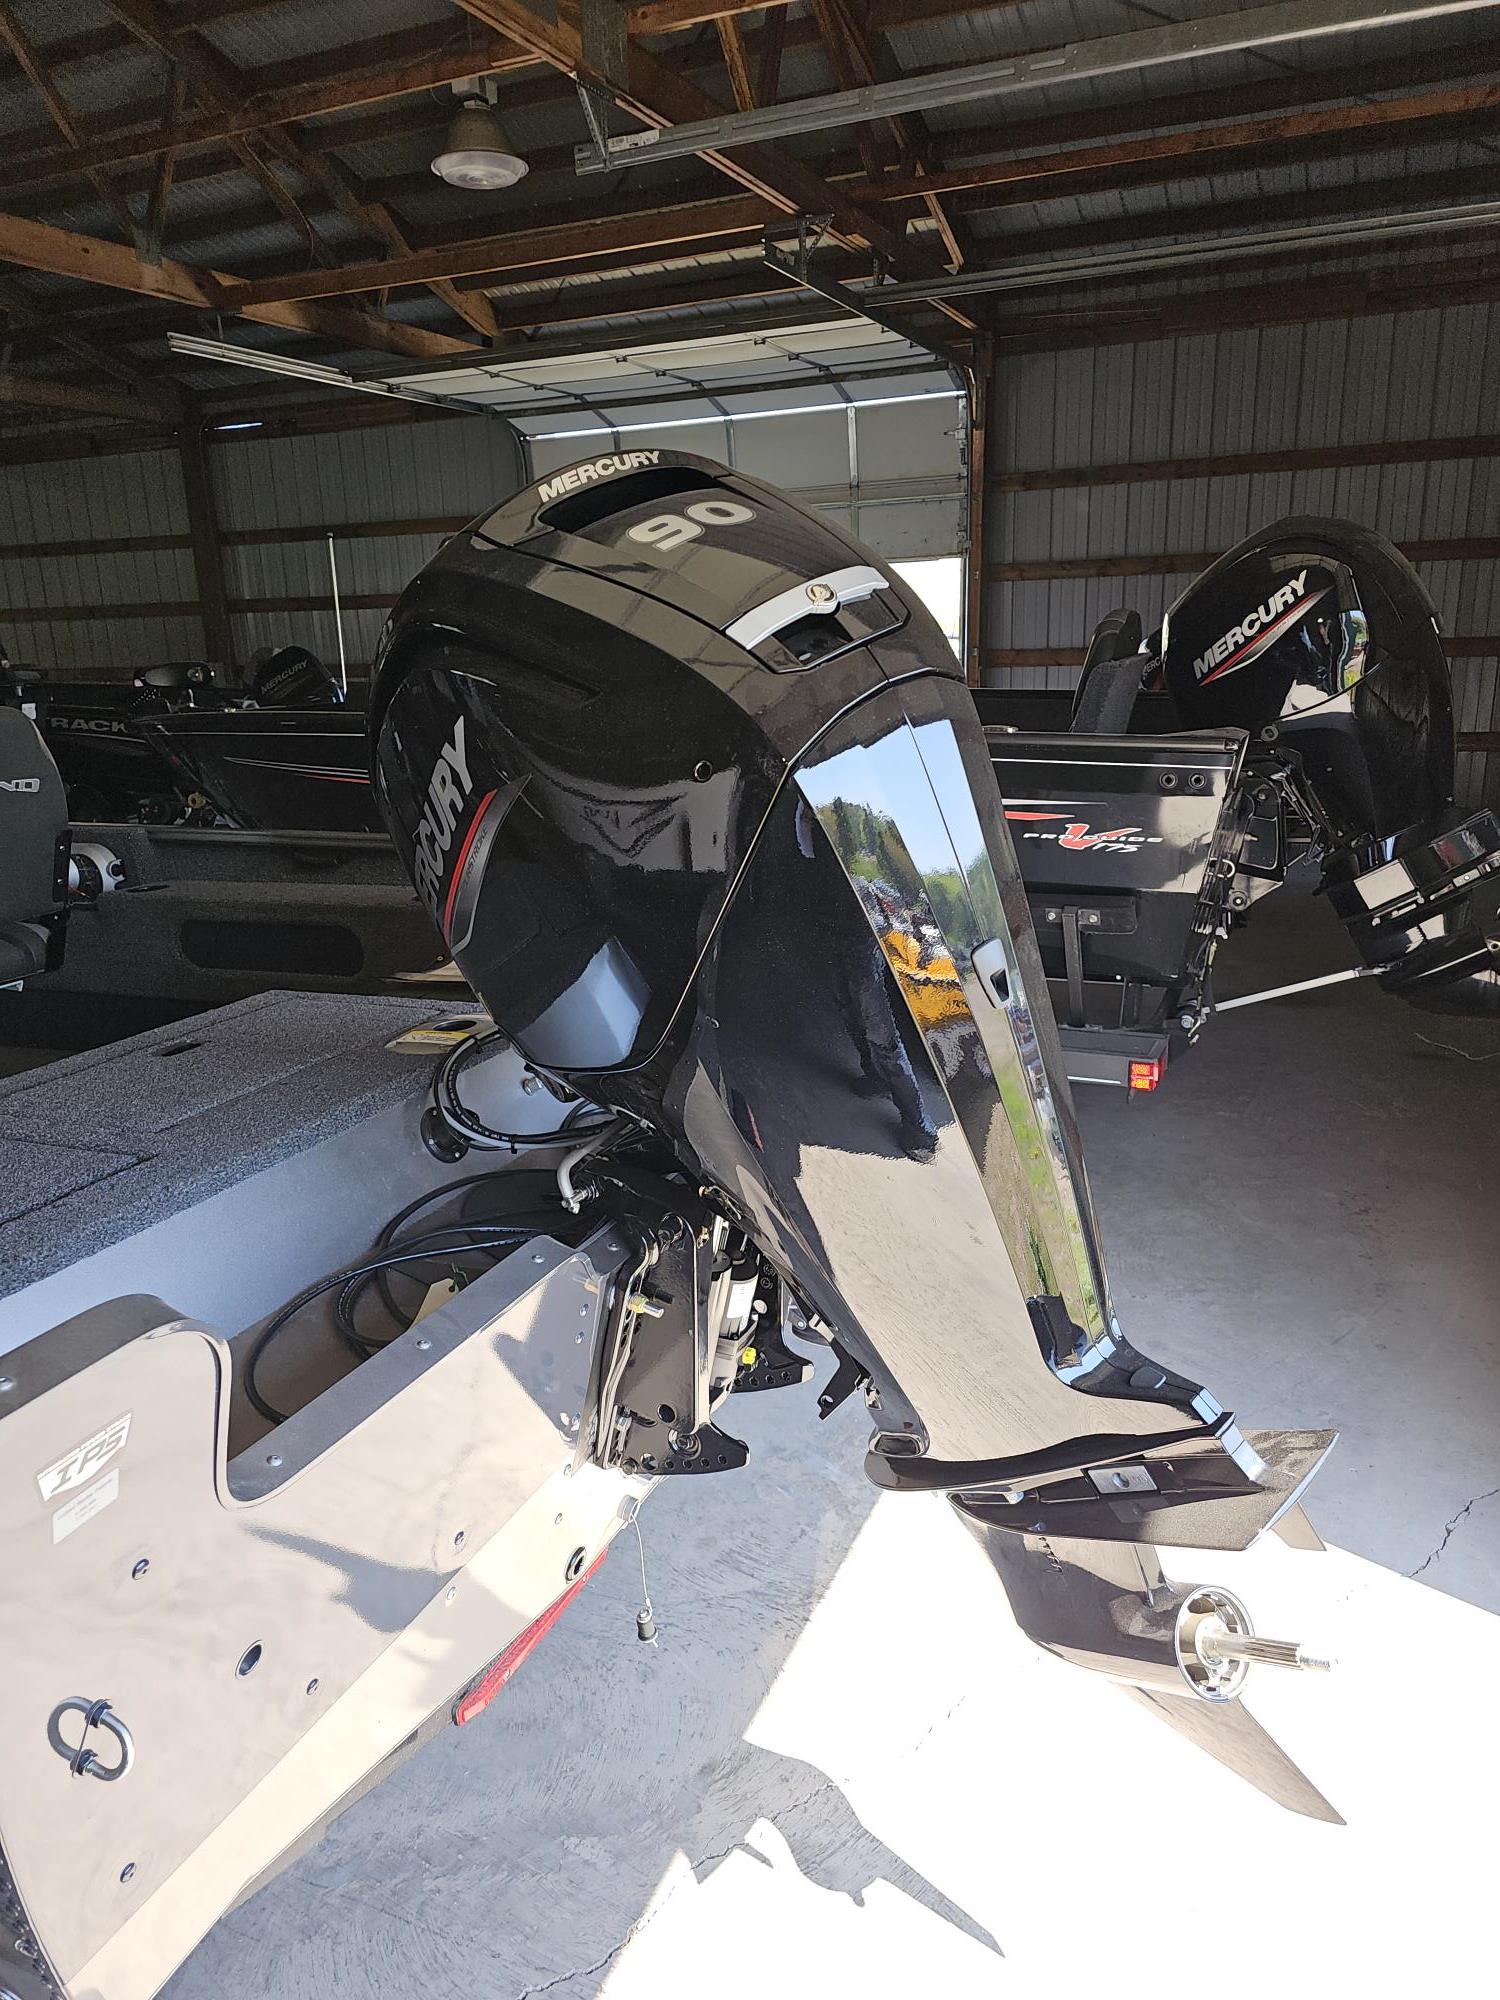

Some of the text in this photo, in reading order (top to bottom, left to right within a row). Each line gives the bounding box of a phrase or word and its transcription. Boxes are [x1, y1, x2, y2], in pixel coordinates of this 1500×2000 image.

[537, 451, 659, 502] MERCURY
[626, 501, 756, 551] 90
[1193, 569, 1307, 679] MERCURY
[261, 659, 308, 694] MERCURY
[49, 717, 128, 733] RACK
[50, 1426, 126, 1494] IPS
